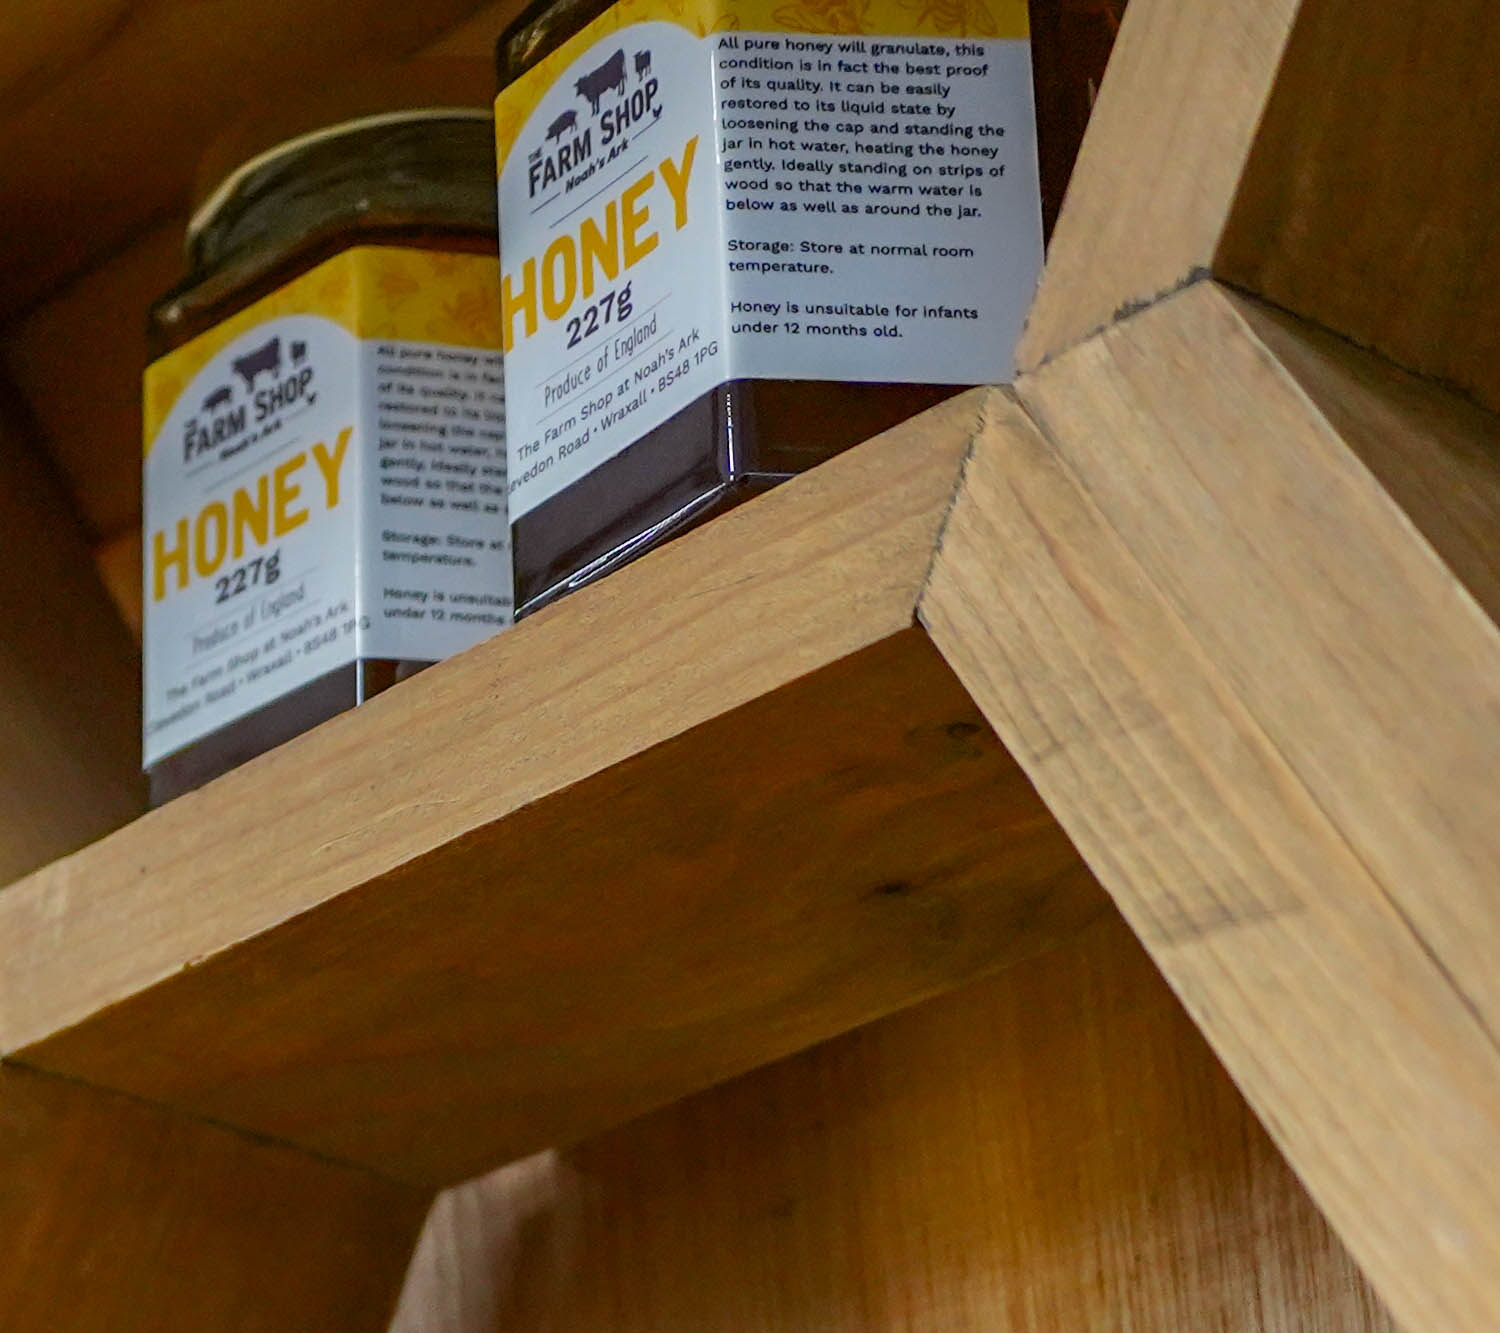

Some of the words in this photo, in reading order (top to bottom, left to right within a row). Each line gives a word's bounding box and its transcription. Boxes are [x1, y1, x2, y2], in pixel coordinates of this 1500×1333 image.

[529, 137, 592, 199] FARM
[601, 78, 658, 145] SHOP
[566, 156, 605, 194] Noah's
[608, 138, 629, 165] Ark
[502, 136, 698, 353] HONEY
[545, 366, 591, 408] Produce
[597, 348, 608, 373] of
[615, 313, 656, 361] England
[566, 281, 633, 349] 227g
[183, 408, 246, 461] FARM
[254, 369, 313, 417] SHOP
[518, 440, 539, 461] The
[545, 417, 575, 443] Farm
[581, 393, 613, 420] Shop
[618, 380, 630, 396] at
[635, 349, 674, 382] Noah's
[679, 328, 700, 353] Ark
[559, 430, 590, 460] Road
[601, 394, 647, 431] Wraxall
[658, 362, 690, 392] BS48
[695, 341, 718, 365] 1PG
[152, 427, 354, 601] HONEY
[215, 548, 281, 603] 227g
